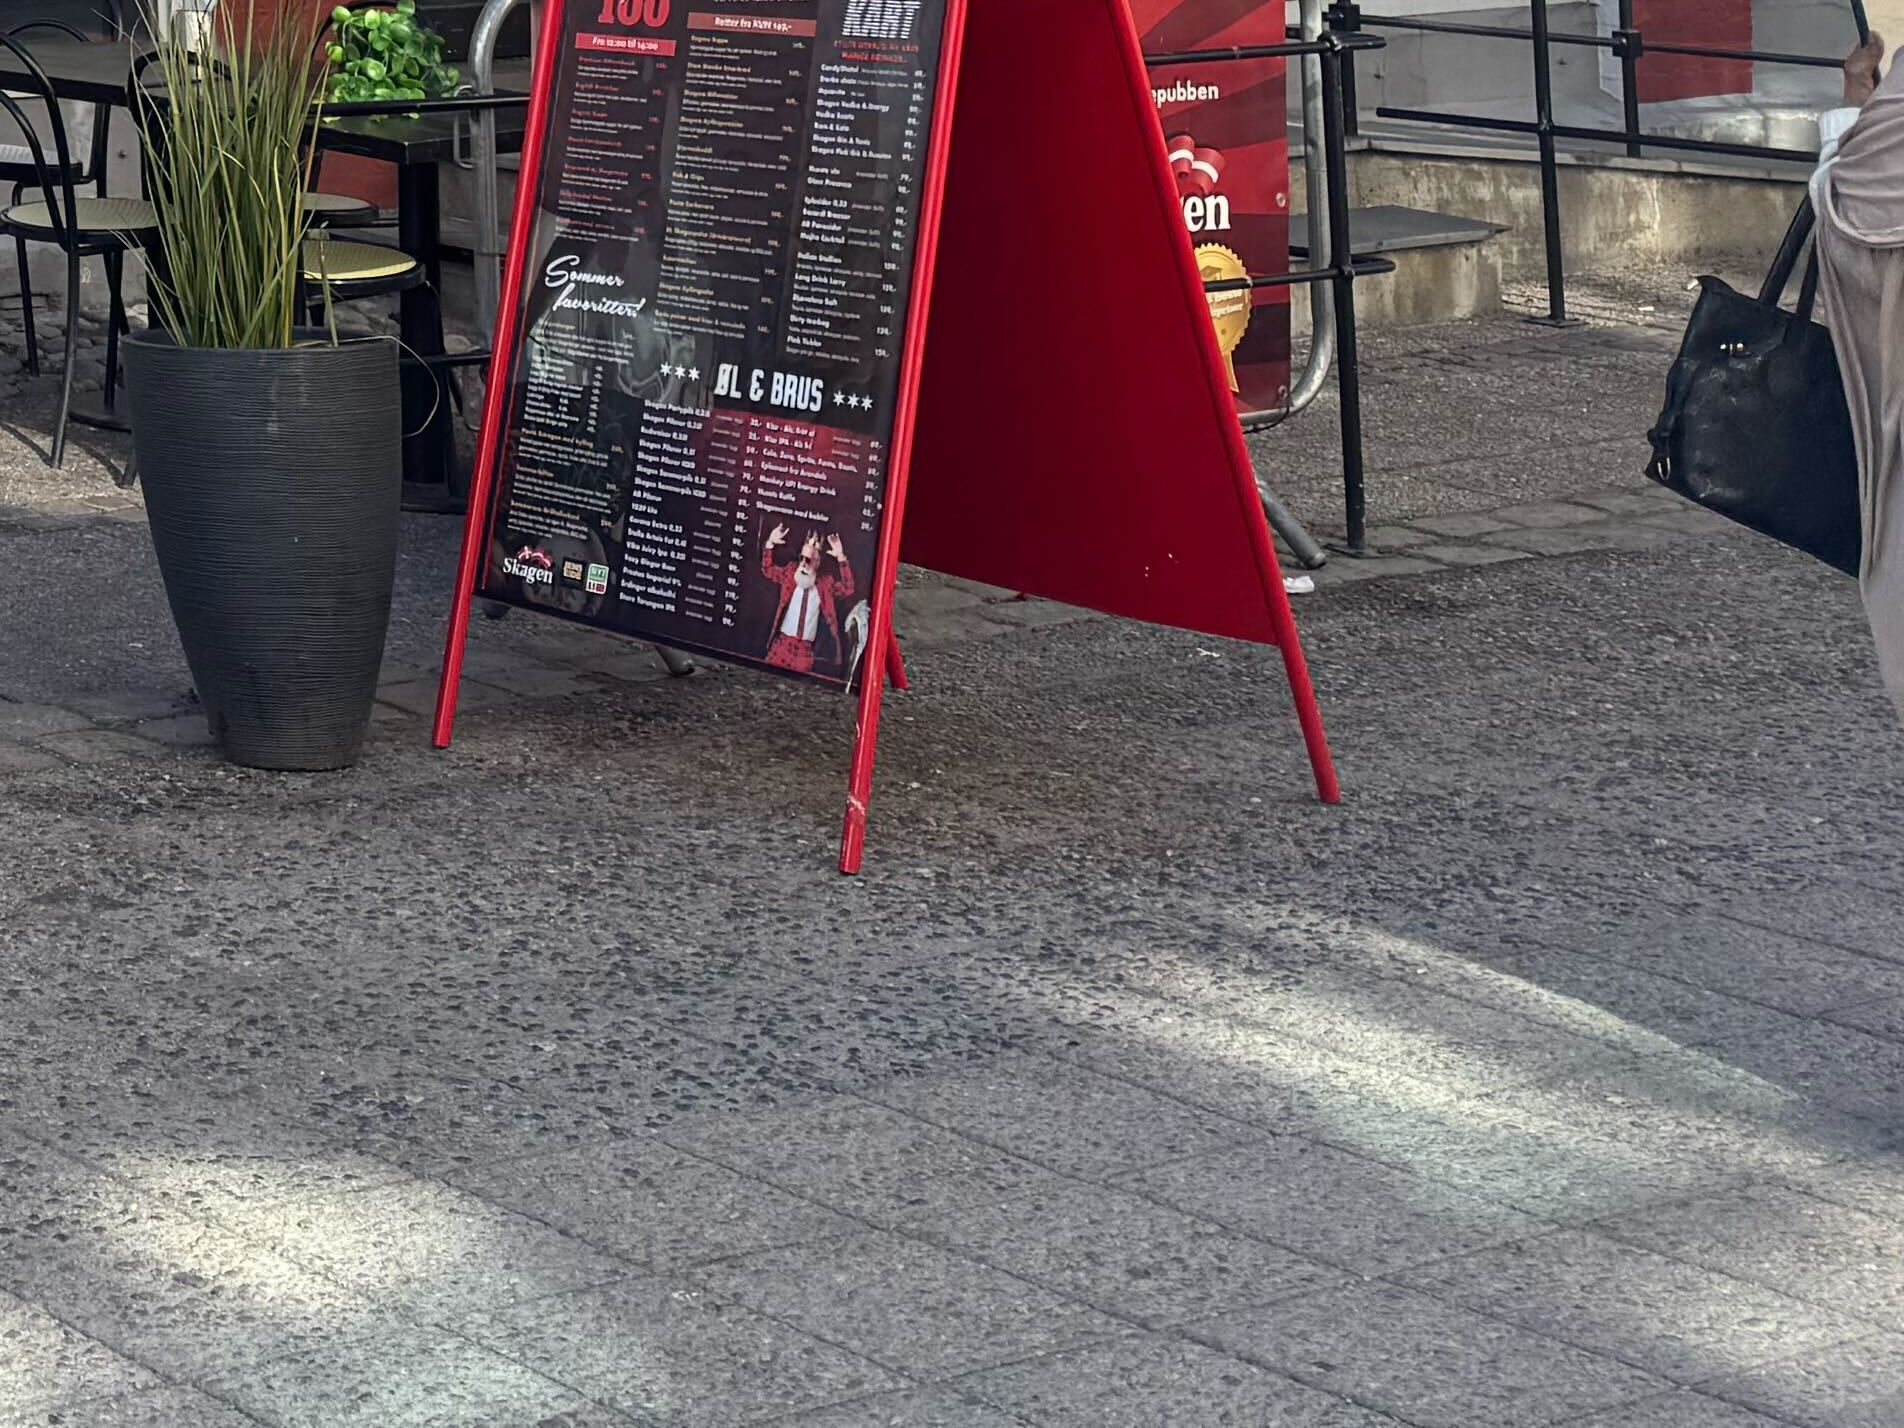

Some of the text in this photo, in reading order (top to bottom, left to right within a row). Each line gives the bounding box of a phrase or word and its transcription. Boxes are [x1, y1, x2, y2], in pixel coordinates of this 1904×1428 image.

[1152, 80, 1219, 108] epubben
[545, 255, 625, 287] Sommer
[552, 283, 646, 318] favoritter!
[714, 363, 824, 412] ØL & BRUS
[503, 557, 553, 584] Skagen
